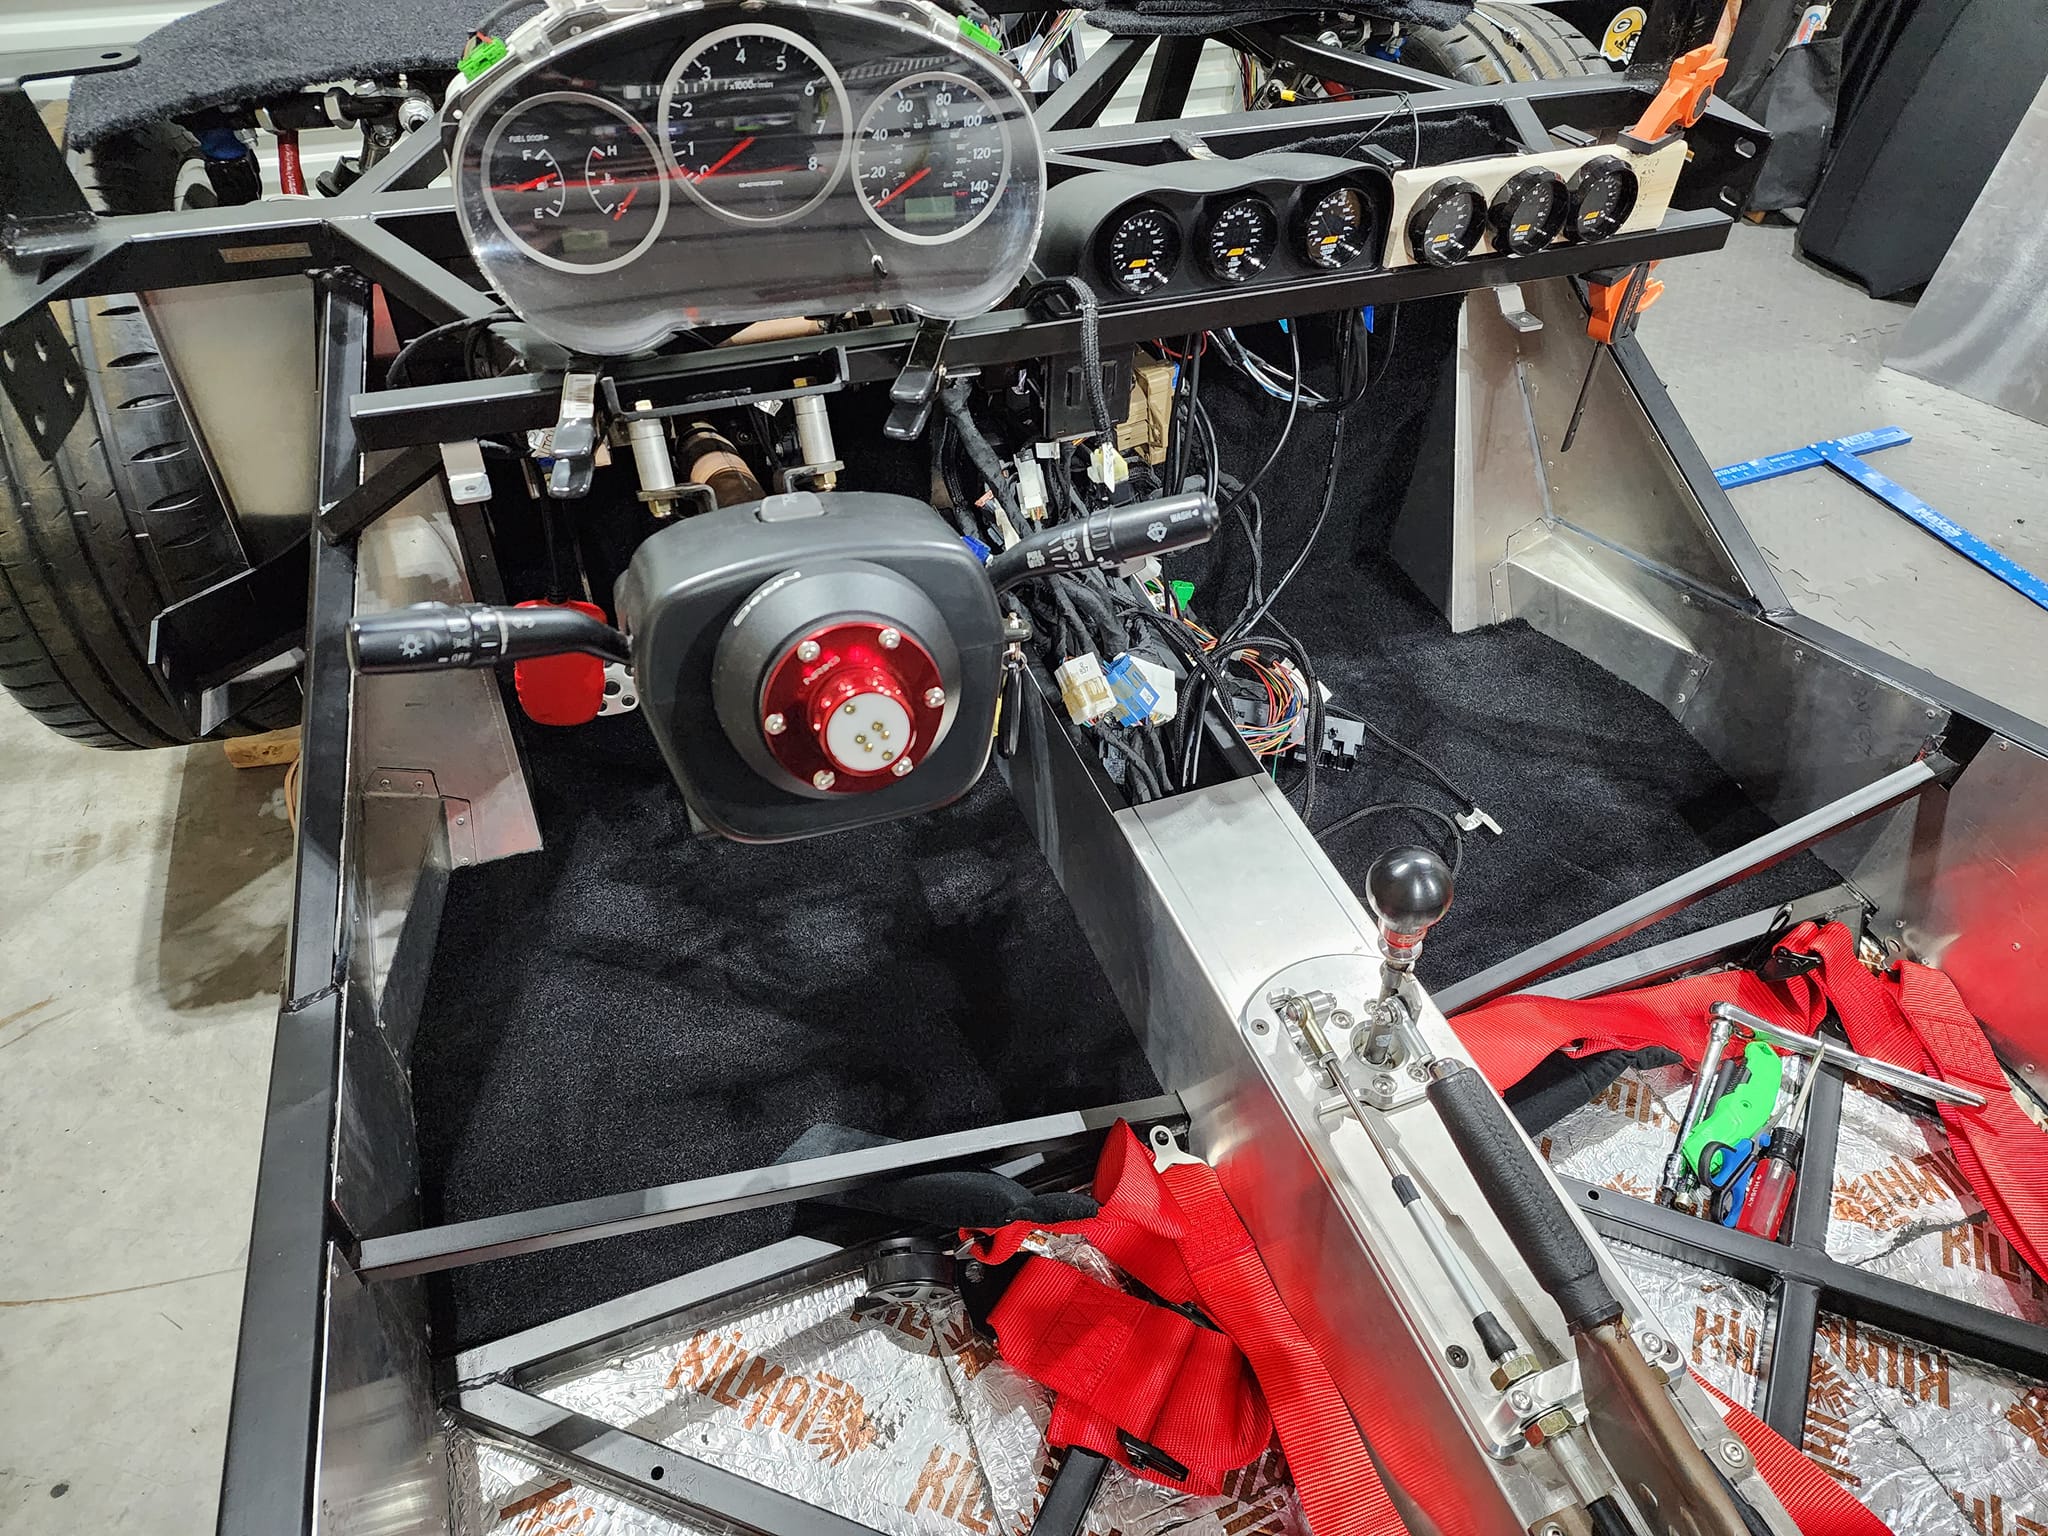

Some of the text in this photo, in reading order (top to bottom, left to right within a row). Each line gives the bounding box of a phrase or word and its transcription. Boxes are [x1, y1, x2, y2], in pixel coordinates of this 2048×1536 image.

[736, 48, 746, 64] 4
[776, 56, 786, 71] 5
[701, 66, 712, 82] 3
[804, 81, 815, 96] 6
[935, 92, 952, 106] 80
[682, 102, 693, 117] 2
[896, 100, 914, 113] 60
[815, 119, 826, 134] 7
[963, 115, 982, 128] 100
[872, 128, 888, 141] 40
[522, 149, 532, 161] F
[607, 145, 618, 157] H
[688, 141, 694, 156] 1
[972, 147, 991, 160] 120
[808, 156, 818, 171] 8
[870, 166, 886, 179] 20
[970, 180, 989, 192] 140
[881, 188, 891, 200] 0
[534, 208, 544, 219] E
[451, 652, 471, 662] OFF
[1747, 1181, 1761, 1208] HUSKY
